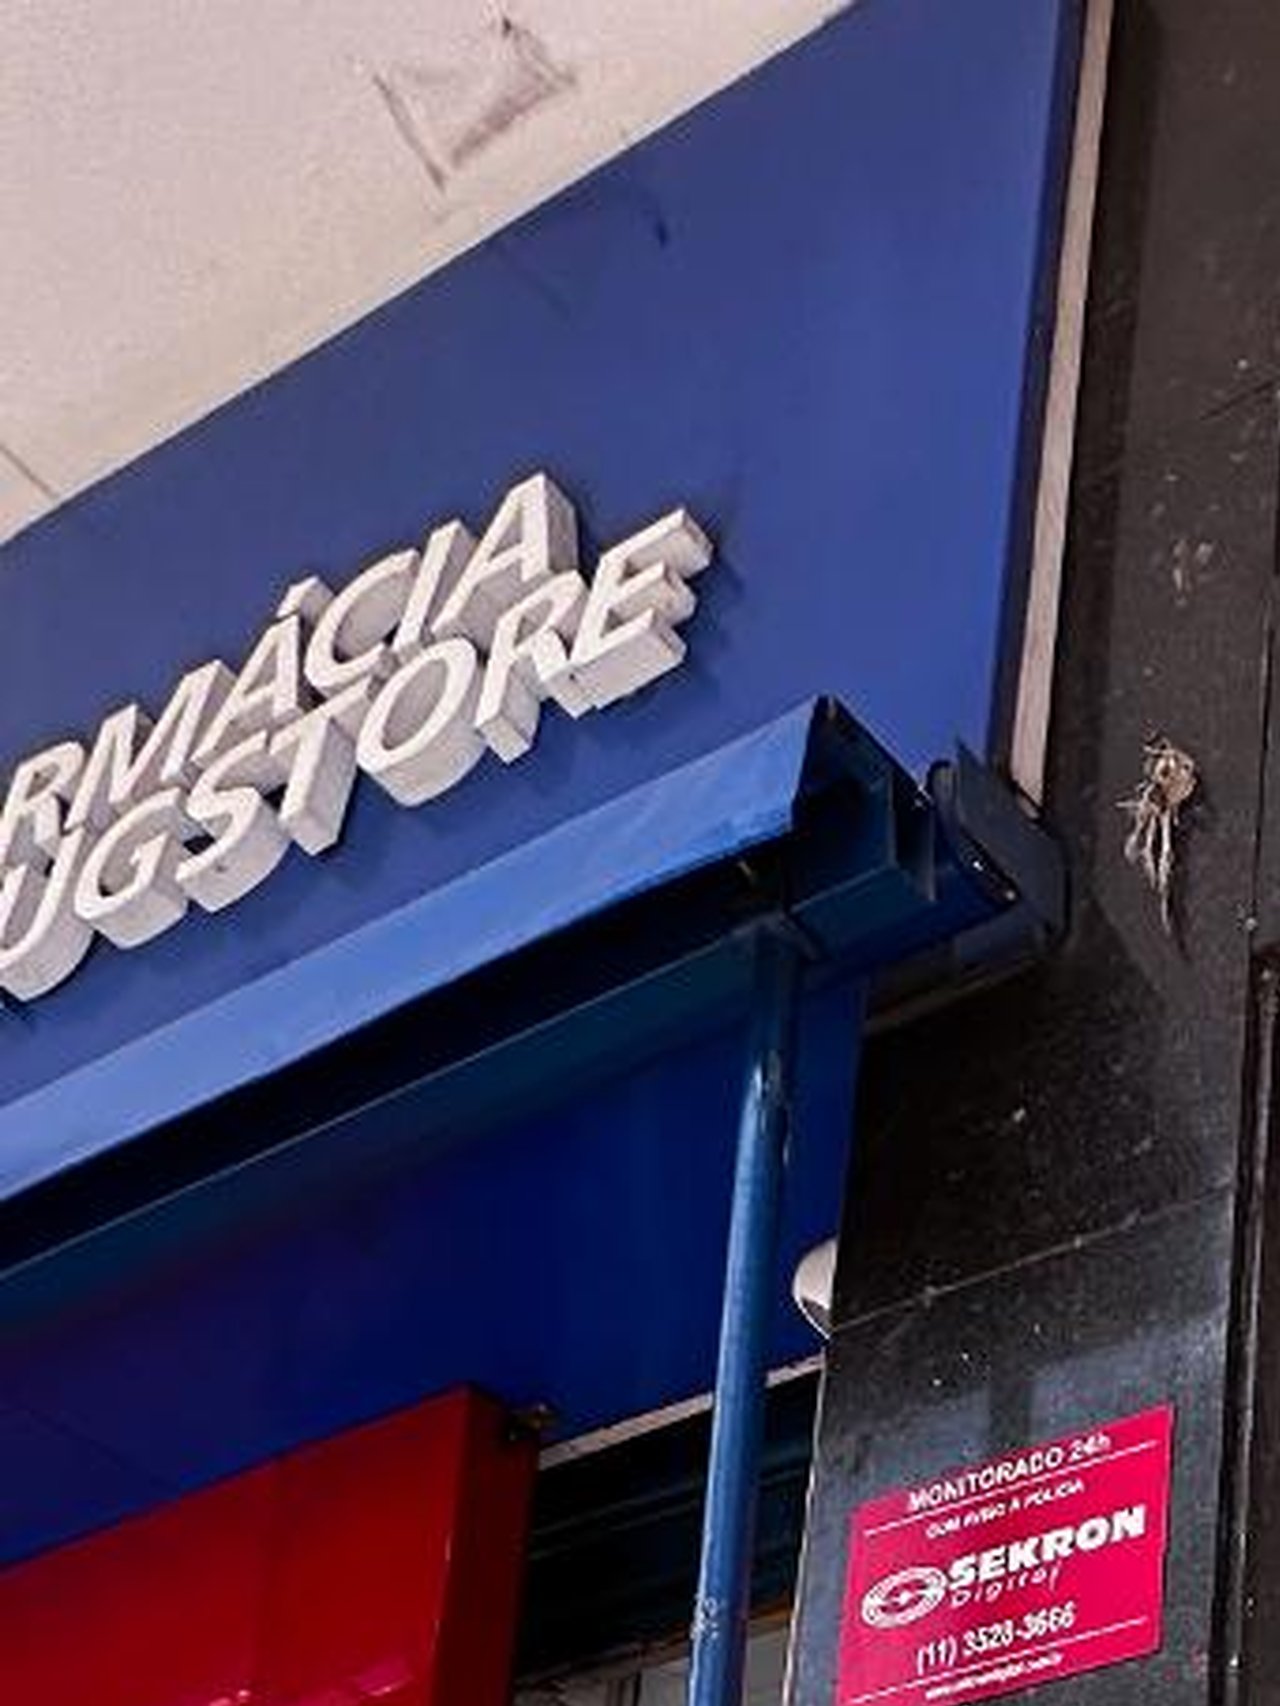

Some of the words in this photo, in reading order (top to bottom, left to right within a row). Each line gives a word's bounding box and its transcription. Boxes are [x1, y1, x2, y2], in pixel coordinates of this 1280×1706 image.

[907, 1447, 1064, 1512] MONITORADO
[947, 1504, 1147, 1592] SEKRON
[916, 1634, 957, 1676] (11)
